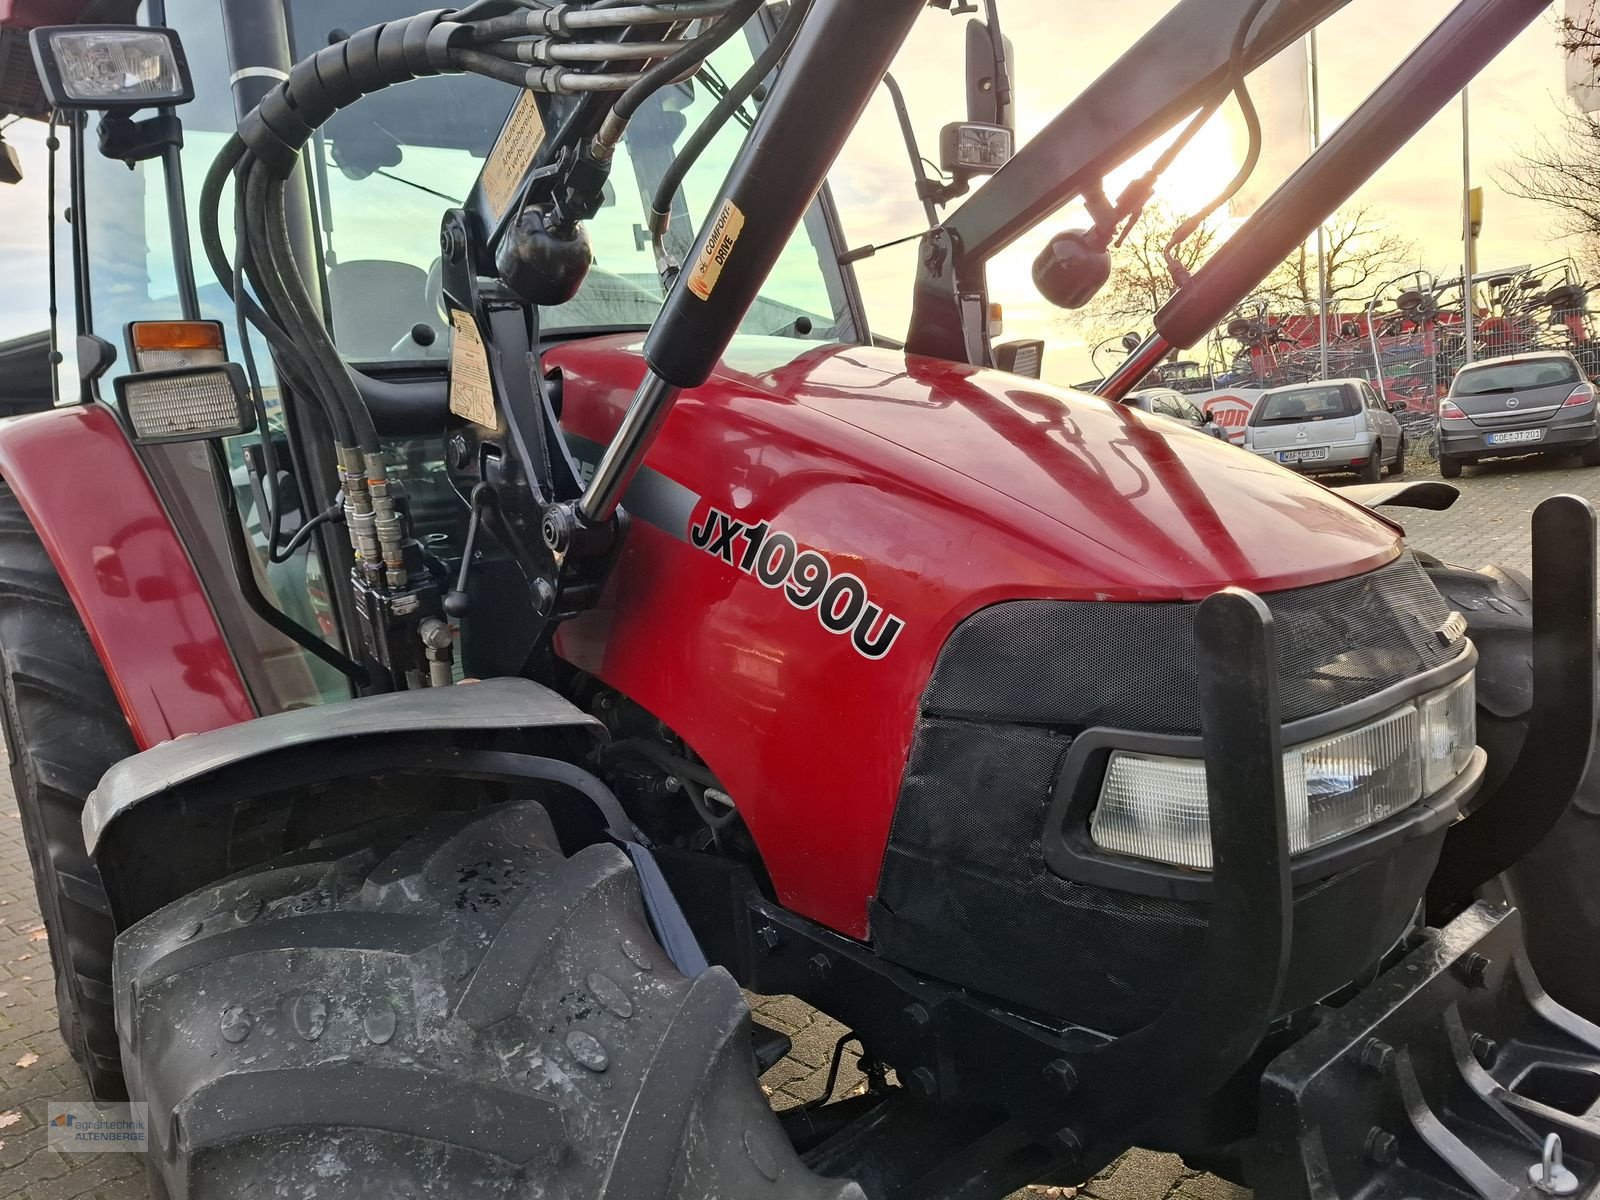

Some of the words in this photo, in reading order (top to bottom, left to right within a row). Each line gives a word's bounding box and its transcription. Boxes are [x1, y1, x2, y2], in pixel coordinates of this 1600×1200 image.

[501, 101, 535, 168] Arbeitsbereich
[503, 97, 528, 146] Aufenthalt
[510, 124, 533, 170] verboten!
[705, 204, 731, 256] COMFORT-
[715, 234, 734, 266] DRIVE
[691, 506, 906, 661] JX1090U
